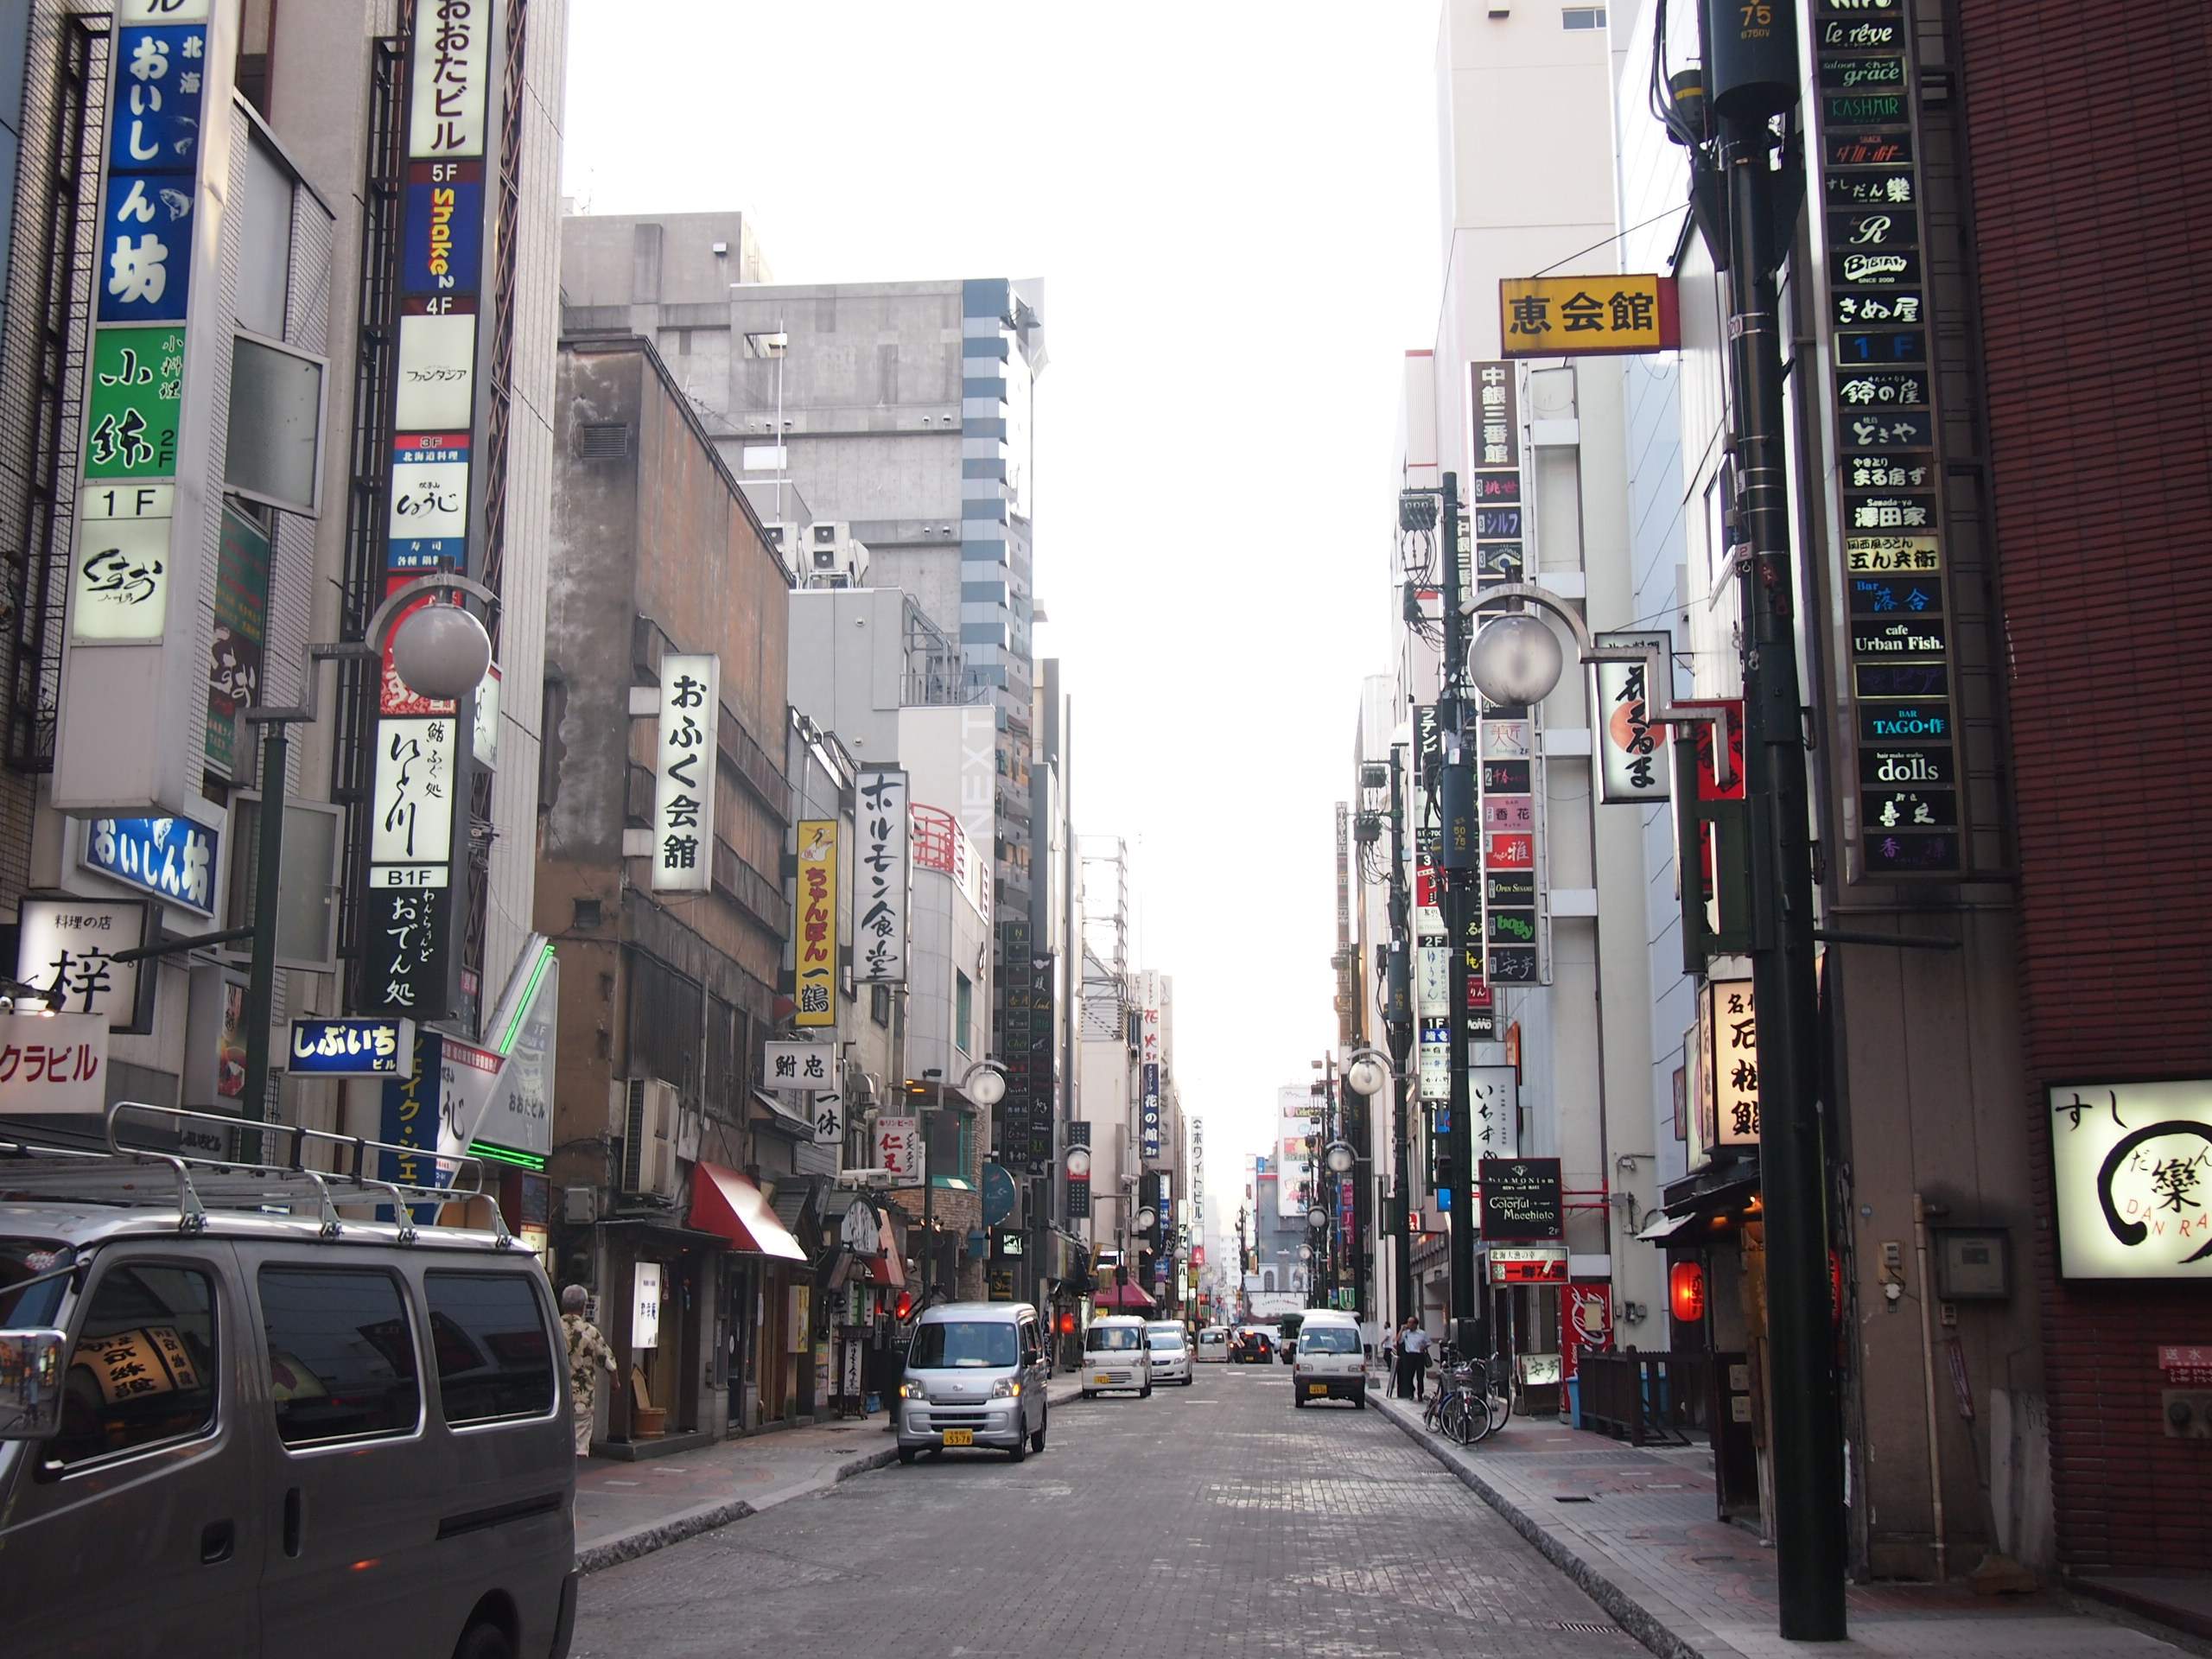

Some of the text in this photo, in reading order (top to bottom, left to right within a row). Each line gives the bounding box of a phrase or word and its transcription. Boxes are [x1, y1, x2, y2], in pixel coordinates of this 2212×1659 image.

[1825, 22, 1892, 43] le rêve
[431, 0, 470, 150] おおたビル
[1843, 68, 1900, 87] grace
[1832, 98, 1899, 117] KASHMIR
[108, 35, 169, 304] おいしん坊
[432, 164, 458, 181] 5F
[1827, 179, 1850, 190] すし
[426, 296, 452, 315] 4F
[1509, 291, 1654, 334] 恵会館
[1839, 296, 1919, 323] きぬ屋
[406, 369, 467, 382] ファンタジア
[1481, 366, 1509, 464] 中銀三番館
[158, 429, 175, 468] 2F
[420, 436, 443, 448] 3F
[403, 450, 459, 462] 北海道料理
[1853, 457, 1888, 467] やきとり
[103, 489, 156, 517] 1F
[1885, 624, 1909, 635] cafe
[1854, 635, 1945, 652] Urban Fish.
[961, 707, 994, 840] NEXT
[1877, 758, 1940, 782] dolls
[94, 818, 210, 907] おいしん坊
[388, 870, 432, 886] B1F
[861, 772, 905, 979] ホルモン食堂
[54, 915, 113, 931] 料理の店
[383, 896, 419, 1006] おでん処
[1426, 937, 1443, 947] 2F
[49, 946, 113, 1013] 梓
[1427, 1018, 1445, 1029] 1F
[293, 1026, 396, 1058] しぶいち
[0, 1044, 99, 1084] クラビル
[372, 1058, 396, 1071] ビル
[816, 1094, 842, 1136] 一休
[2055, 1088, 2128, 1132] すし
[1490, 1196, 1529, 1210] Colorful
[1503, 1209, 1554, 1221] Macchiato
